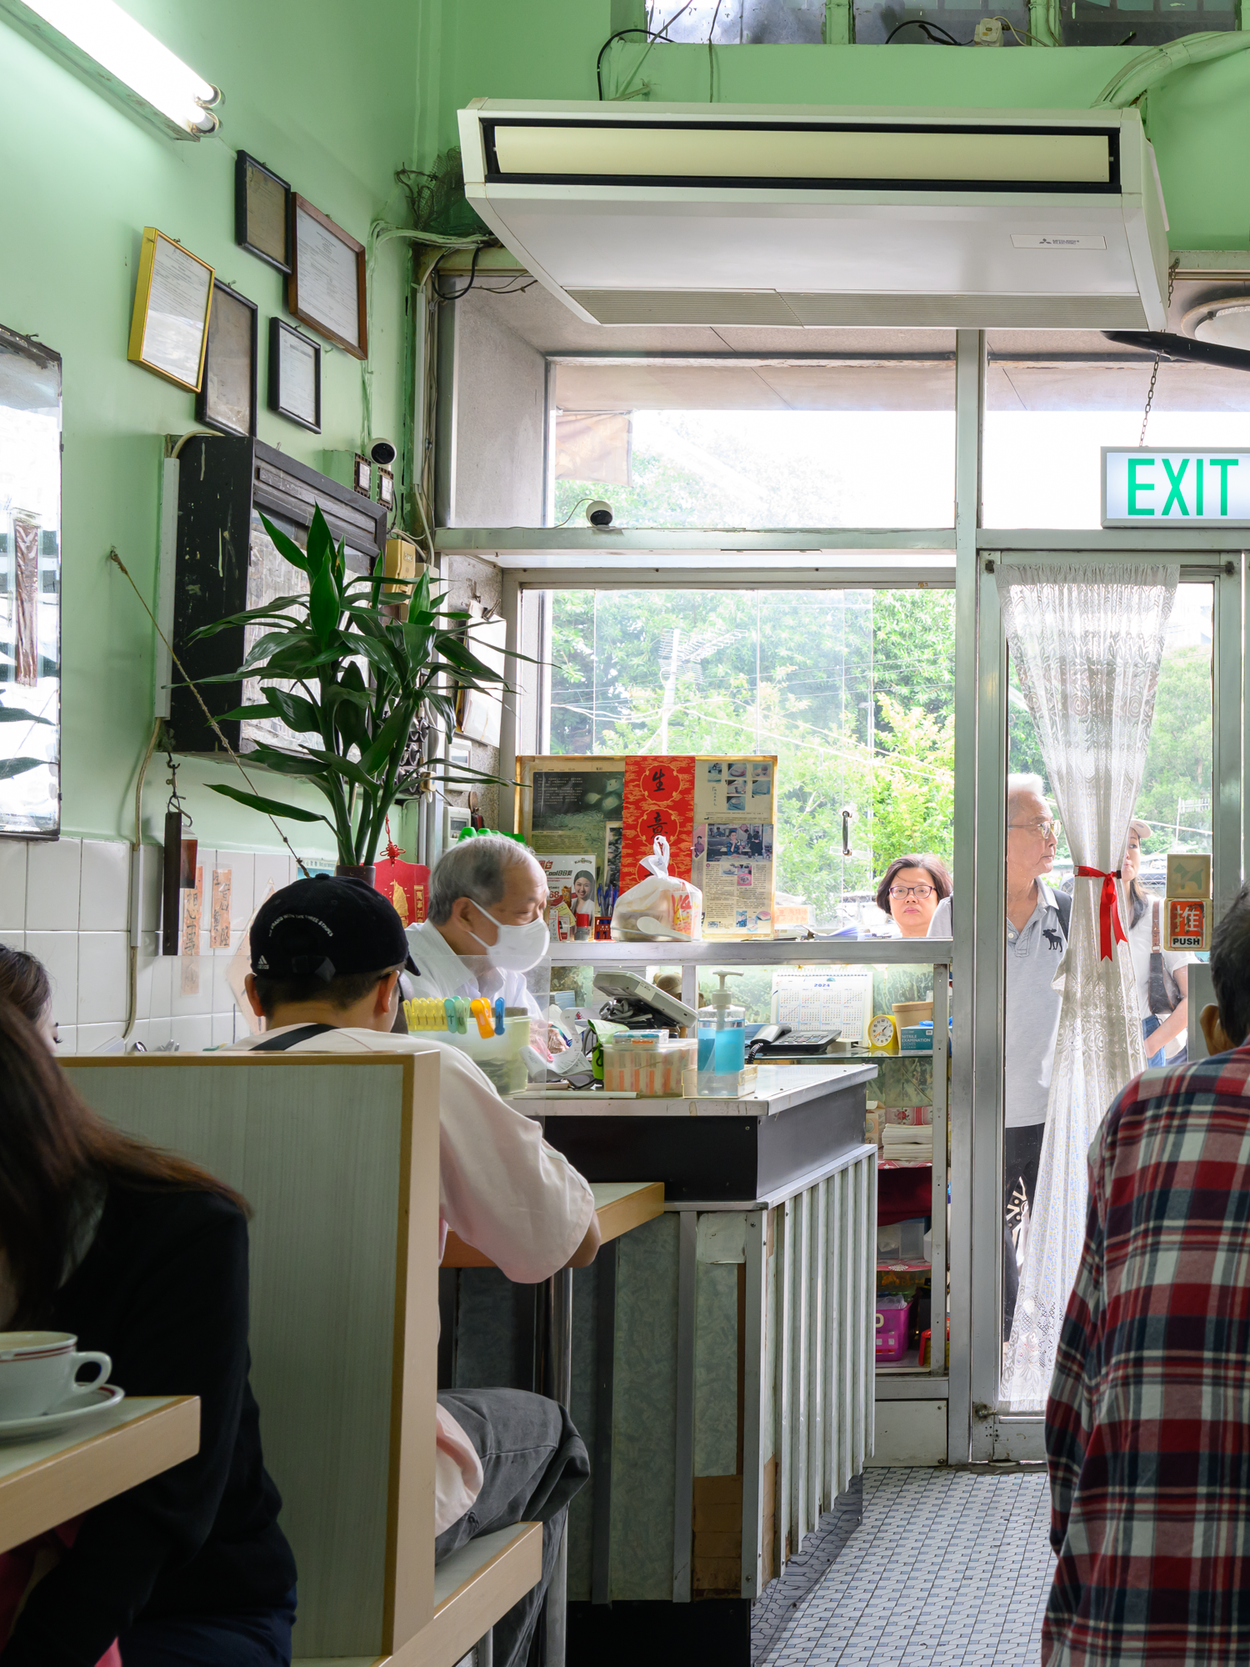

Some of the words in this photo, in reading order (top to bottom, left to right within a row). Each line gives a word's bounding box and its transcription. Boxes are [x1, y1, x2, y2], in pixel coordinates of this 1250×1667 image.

[1127, 458, 1239, 516] EXIT
[644, 768, 669, 878] 生意
[1172, 937, 1201, 945] PUSH
[1173, 904, 1200, 934] 推
